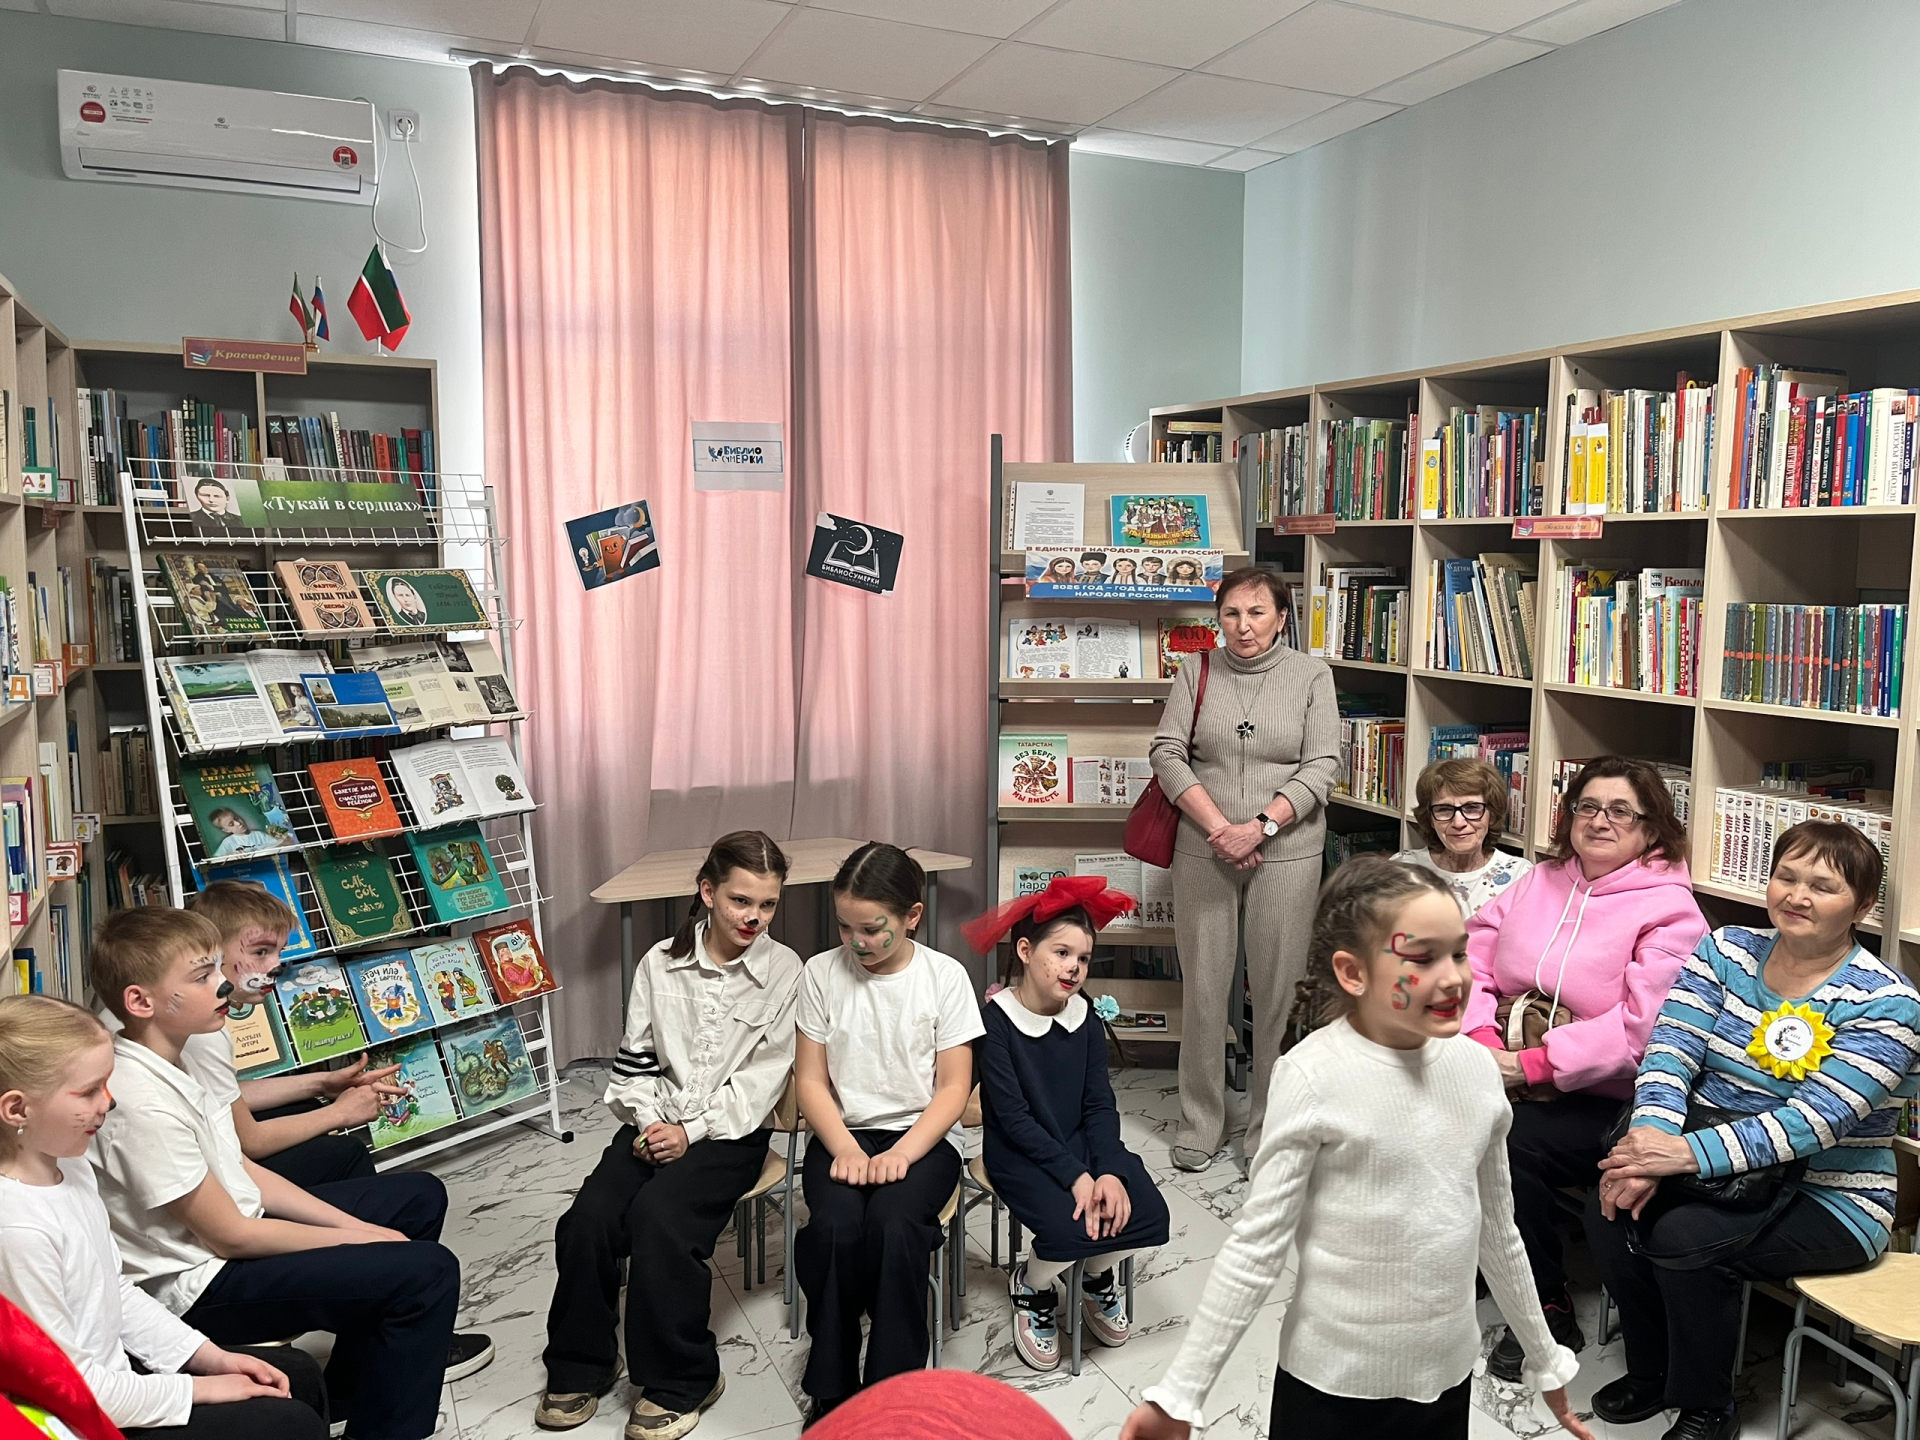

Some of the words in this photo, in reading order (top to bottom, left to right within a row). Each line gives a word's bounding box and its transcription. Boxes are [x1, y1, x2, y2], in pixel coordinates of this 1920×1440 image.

[214, 350, 300, 362] Краеведение
[1892, 422, 1901, 458] РОССИИ
[722, 454, 764, 464] СУМЕРКИ
[724, 446, 762, 454] БИБЛИО
[22, 474, 35, 487] А
[1784, 446, 1798, 498] ЭНЦИКЛОПЕДИЯ
[1890, 461, 1898, 502] ИСТОРИЯ
[263, 496, 328, 514] «Тукай
[336, 501, 345, 510] в
[348, 499, 424, 514] сердцах»
[821, 564, 880, 585] БИБЛИОСУМЕРКИ
[1665, 576, 1704, 587] Ведьм
[300, 592, 335, 600] ГАБДУЛЛА
[336, 590, 358, 599] ТУКАЙ
[1179, 629, 1207, 641] 100
[71, 645, 89, 666] Н
[9, 676, 29, 700] Д
[1014, 750, 1030, 762] БЕЗ
[1012, 791, 1025, 802] МЫ
[1028, 791, 1059, 804] ВМЕСТЕ
[1742, 813, 1751, 833] МИР
[1764, 821, 1772, 840] МИР
[1713, 832, 1721, 866] ПОЗНАЮ
[1723, 834, 1732, 867] ПОЗНАЮ
[1740, 835, 1749, 872] ПОЗНАЮ
[1751, 838, 1760, 872] ПОЗНАЮ
[1761, 842, 1770, 877] ПОЗНАЮ
[1020, 882, 1050, 890] наро
